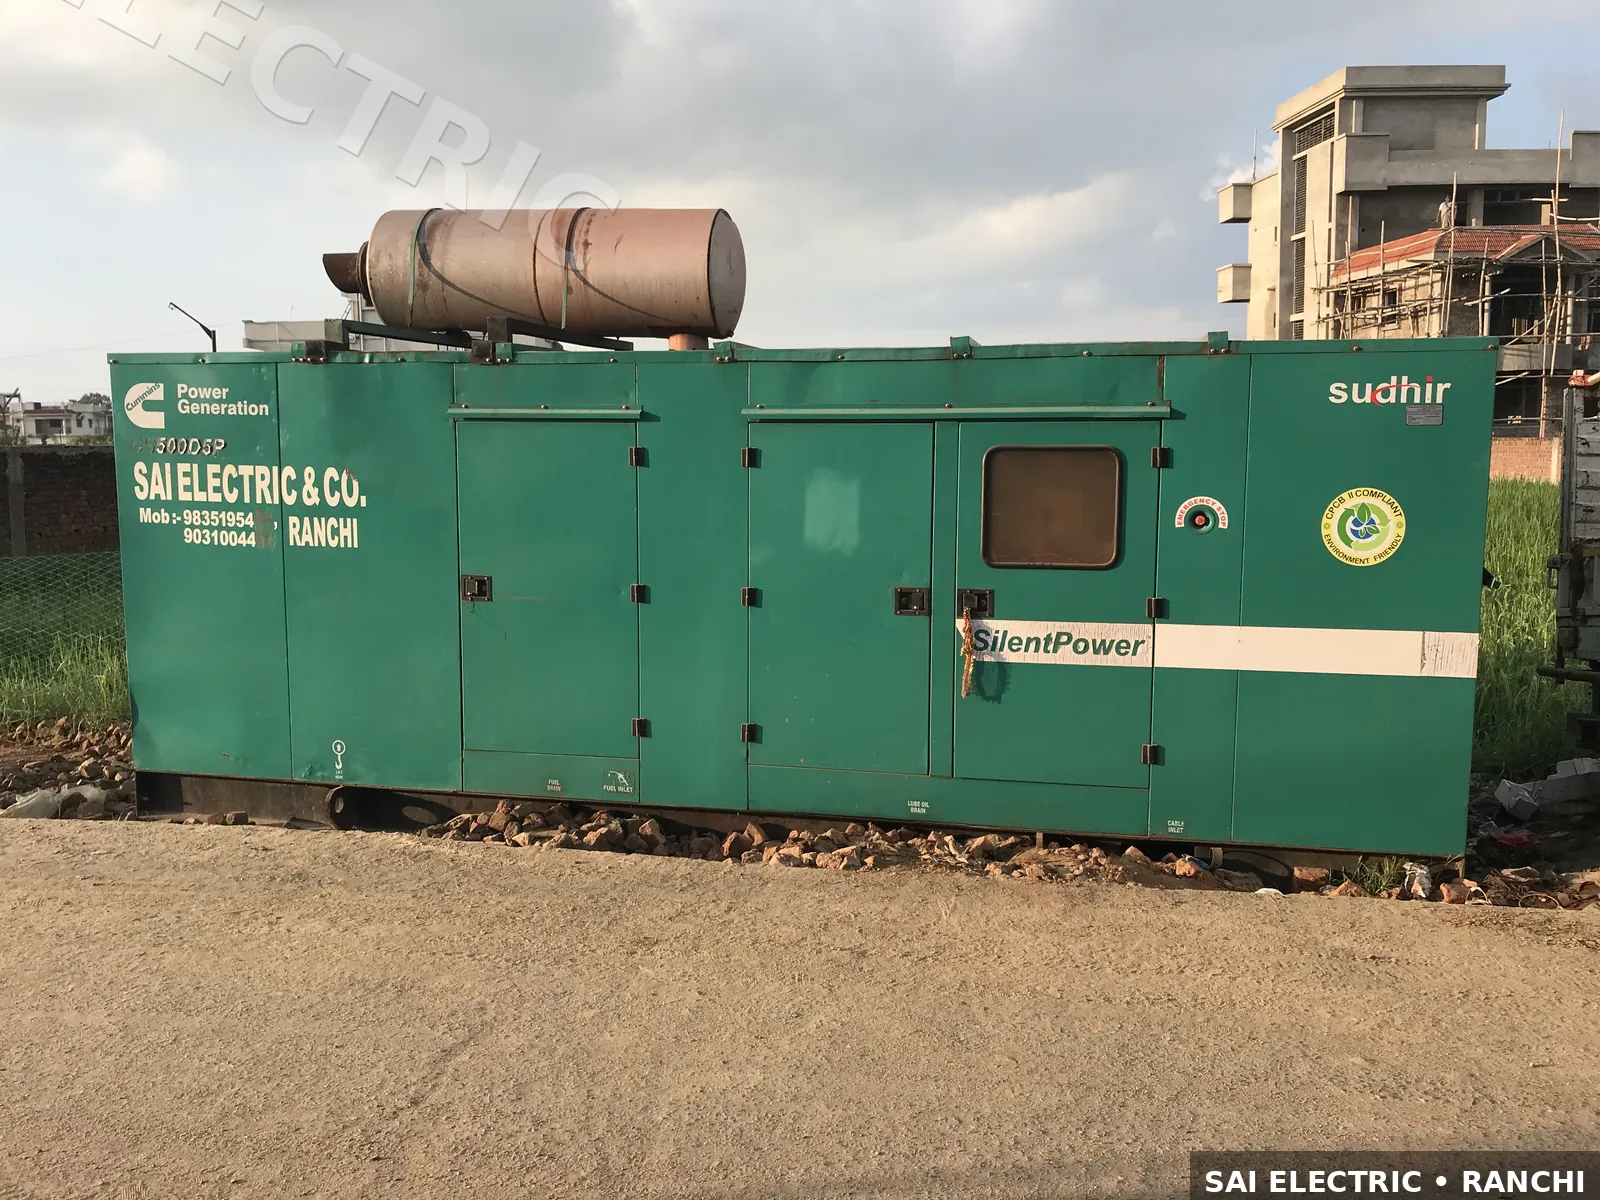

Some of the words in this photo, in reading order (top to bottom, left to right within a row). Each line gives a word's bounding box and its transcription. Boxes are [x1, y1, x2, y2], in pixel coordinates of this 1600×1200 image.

[125, 382, 161, 412] Cummins
[177, 383, 229, 400] Power
[1328, 375, 1452, 404] sudhir
[177, 399, 269, 416] Generation
[133, 461, 173, 501] SAI
[176, 462, 298, 506] ELECTRIC
[301, 466, 321, 507] &
[323, 467, 367, 508] CO.
[1177, 498, 1217, 526] EMERGENCY
[1216, 506, 1227, 527] STOP
[1326, 496, 1346, 520] CPCB
[1355, 489, 1403, 518] COMPLIANT
[288, 515, 359, 549] RANCHI
[1323, 533, 1370, 565] ENVIRONMENT
[1373, 533, 1402, 562] FRIENDLY
[973, 629, 1147, 657] SilentPower
[603, 784, 616, 792] FUEL
[617, 785, 633, 793] INLET
[1168, 826, 1184, 834] INLET
